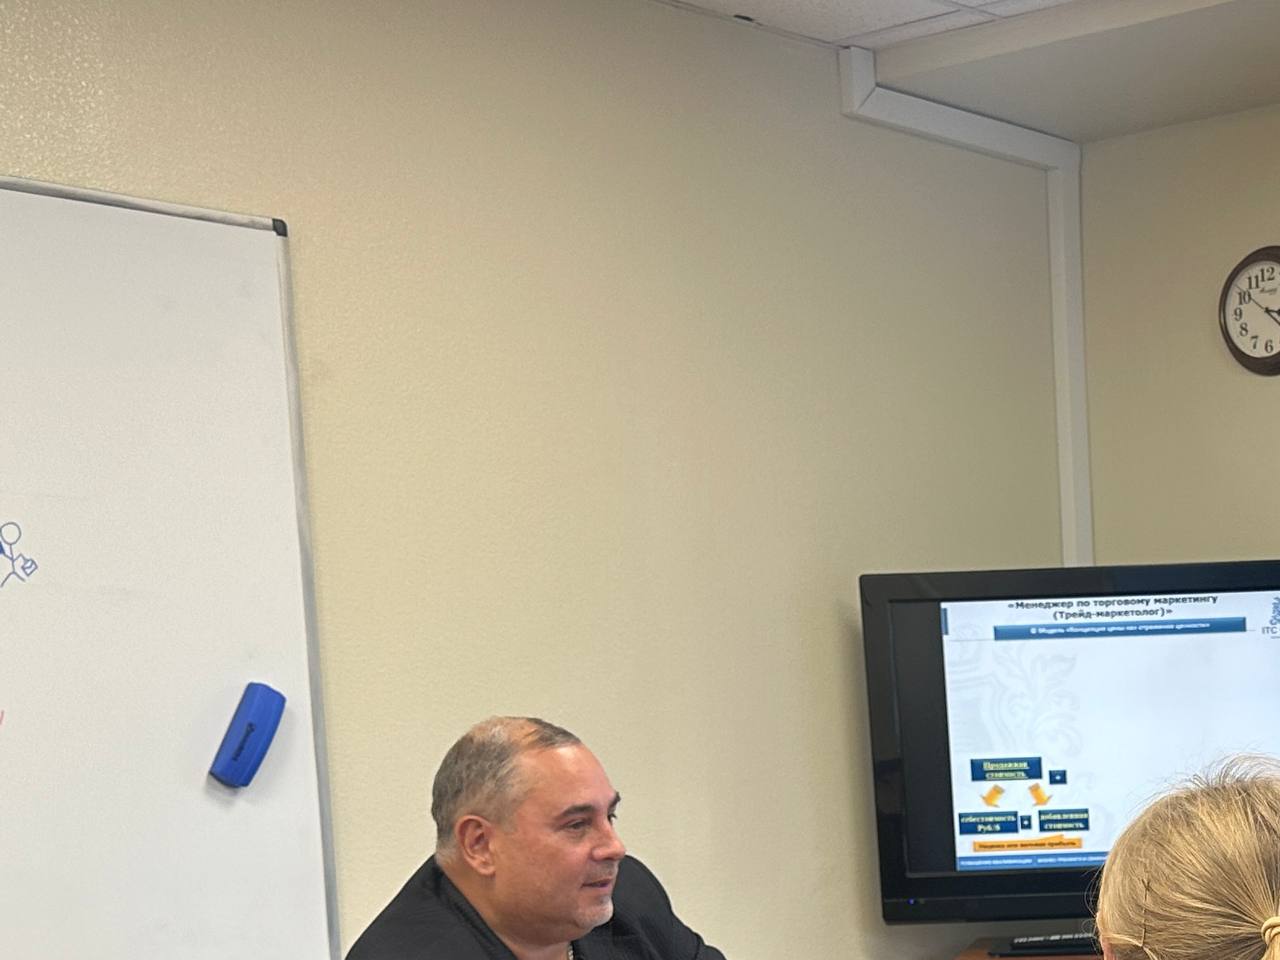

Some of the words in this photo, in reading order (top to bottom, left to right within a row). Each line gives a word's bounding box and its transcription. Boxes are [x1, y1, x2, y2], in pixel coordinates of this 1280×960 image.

[1260, 267, 1275, 282] 12
[1248, 275, 1260, 290] 11
[1239, 290, 1251, 306] 10
[1234, 307, 1242, 321] 9
[1240, 322, 1248, 337] 8
[1251, 335, 1259, 350] 7
[1265, 339, 1273, 353] 6
[1076, 600, 1091, 608] по
[1093, 598, 1151, 608] торговому
[1153, 595, 1218, 605] маркетингу
[1261, 626, 1278, 635] ITC
